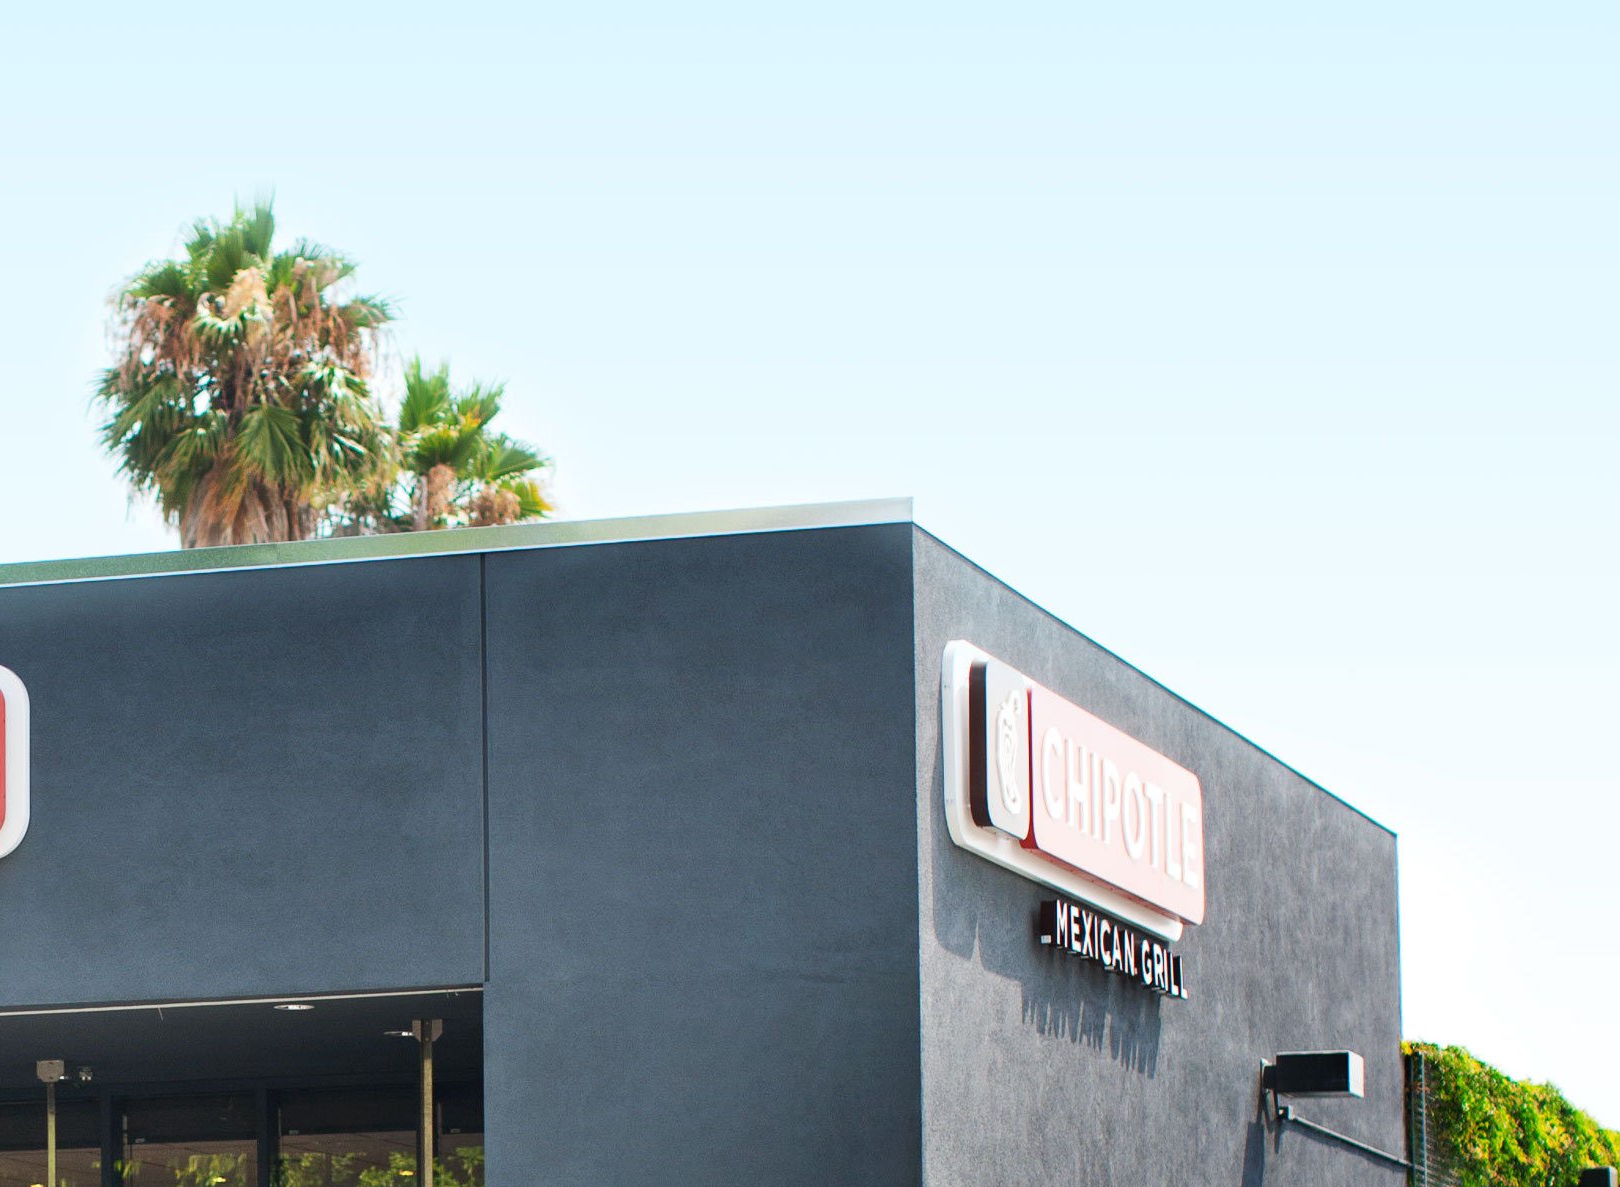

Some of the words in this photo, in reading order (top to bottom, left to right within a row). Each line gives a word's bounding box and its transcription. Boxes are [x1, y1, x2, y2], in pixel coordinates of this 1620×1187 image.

[1040, 726, 1201, 890] CHIPOTLE
[1055, 899, 1138, 977] MEXICAN
[1141, 938, 1189, 1000] GRILL
